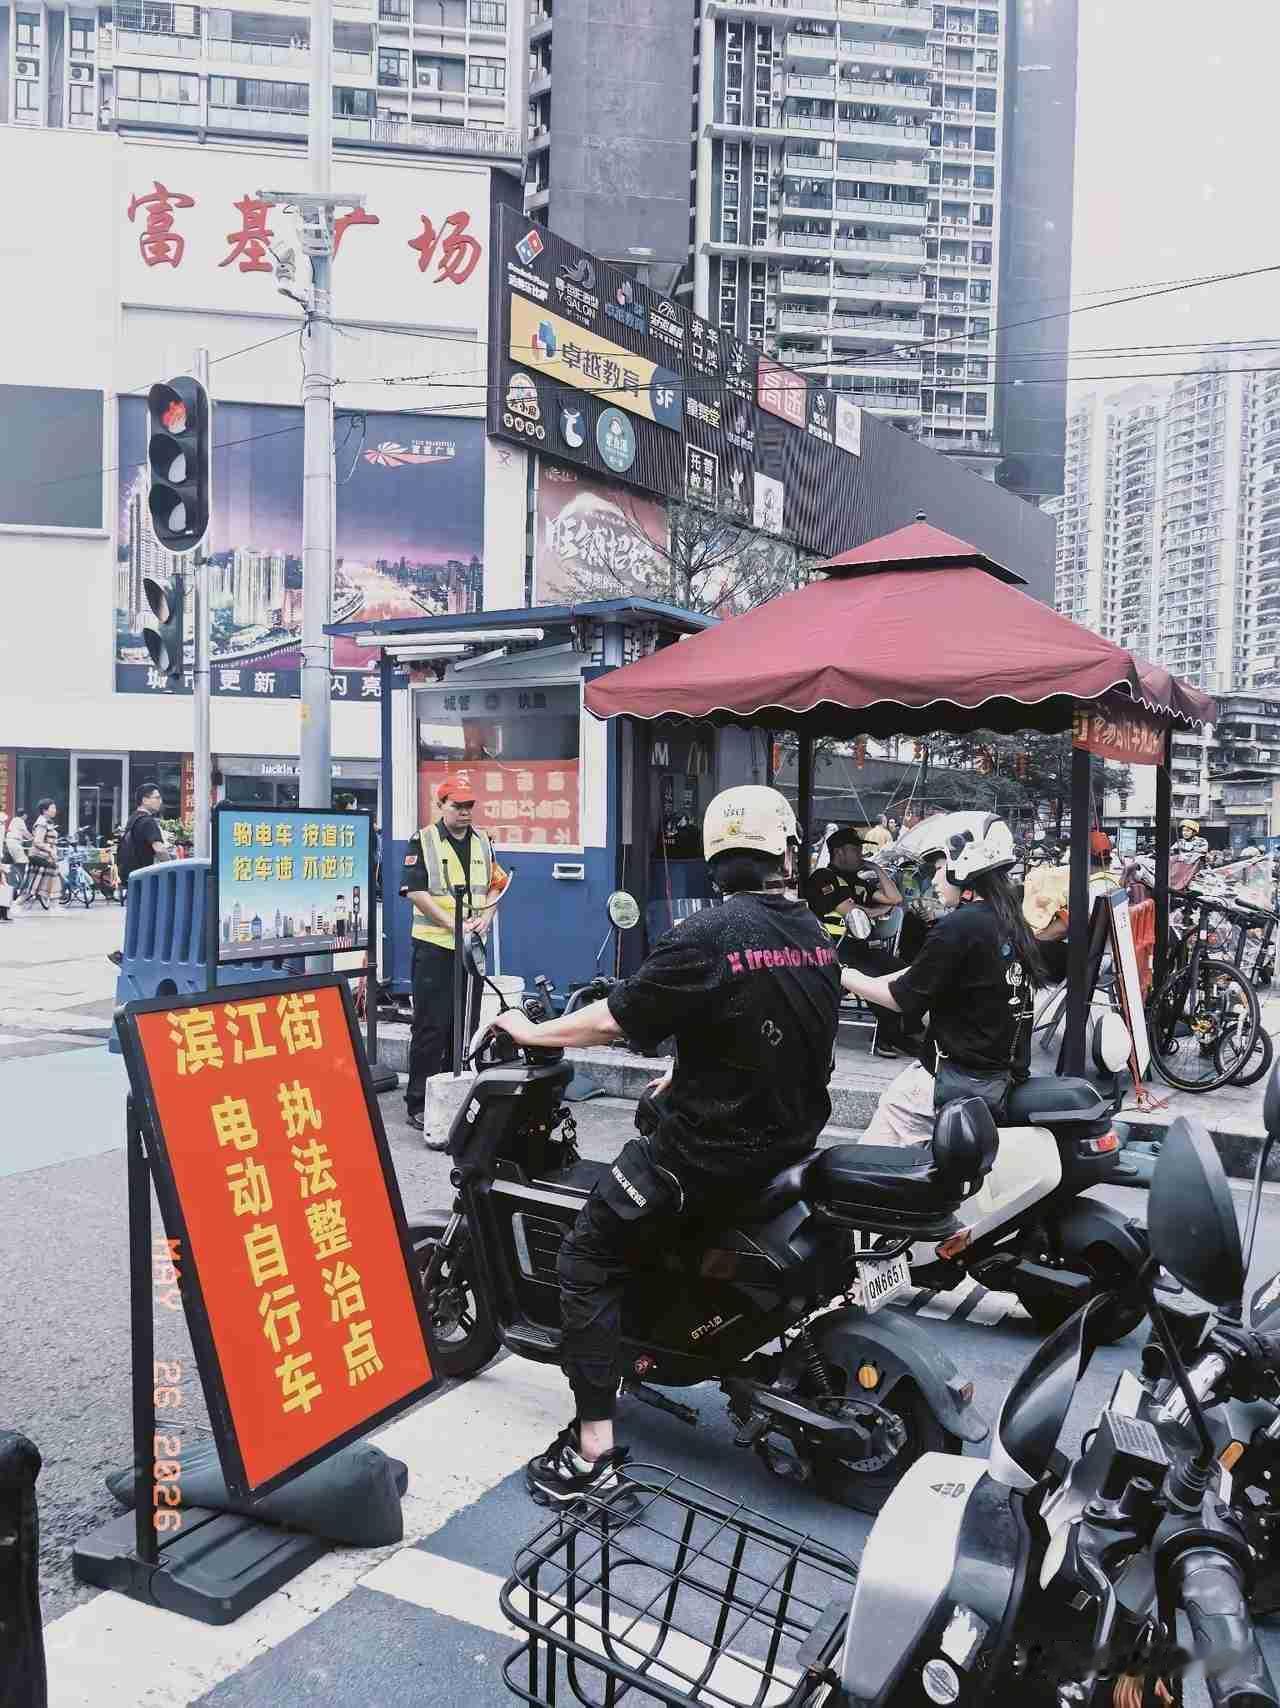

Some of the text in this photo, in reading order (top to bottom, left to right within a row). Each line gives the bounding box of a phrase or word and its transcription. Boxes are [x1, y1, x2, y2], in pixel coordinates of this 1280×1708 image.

[128, 181, 482, 285] 富基广场
[167, 993, 323, 1076] 滨江街
[211, 1096, 323, 1415] 电动自行车
[278, 1080, 384, 1387] 执法整治点
